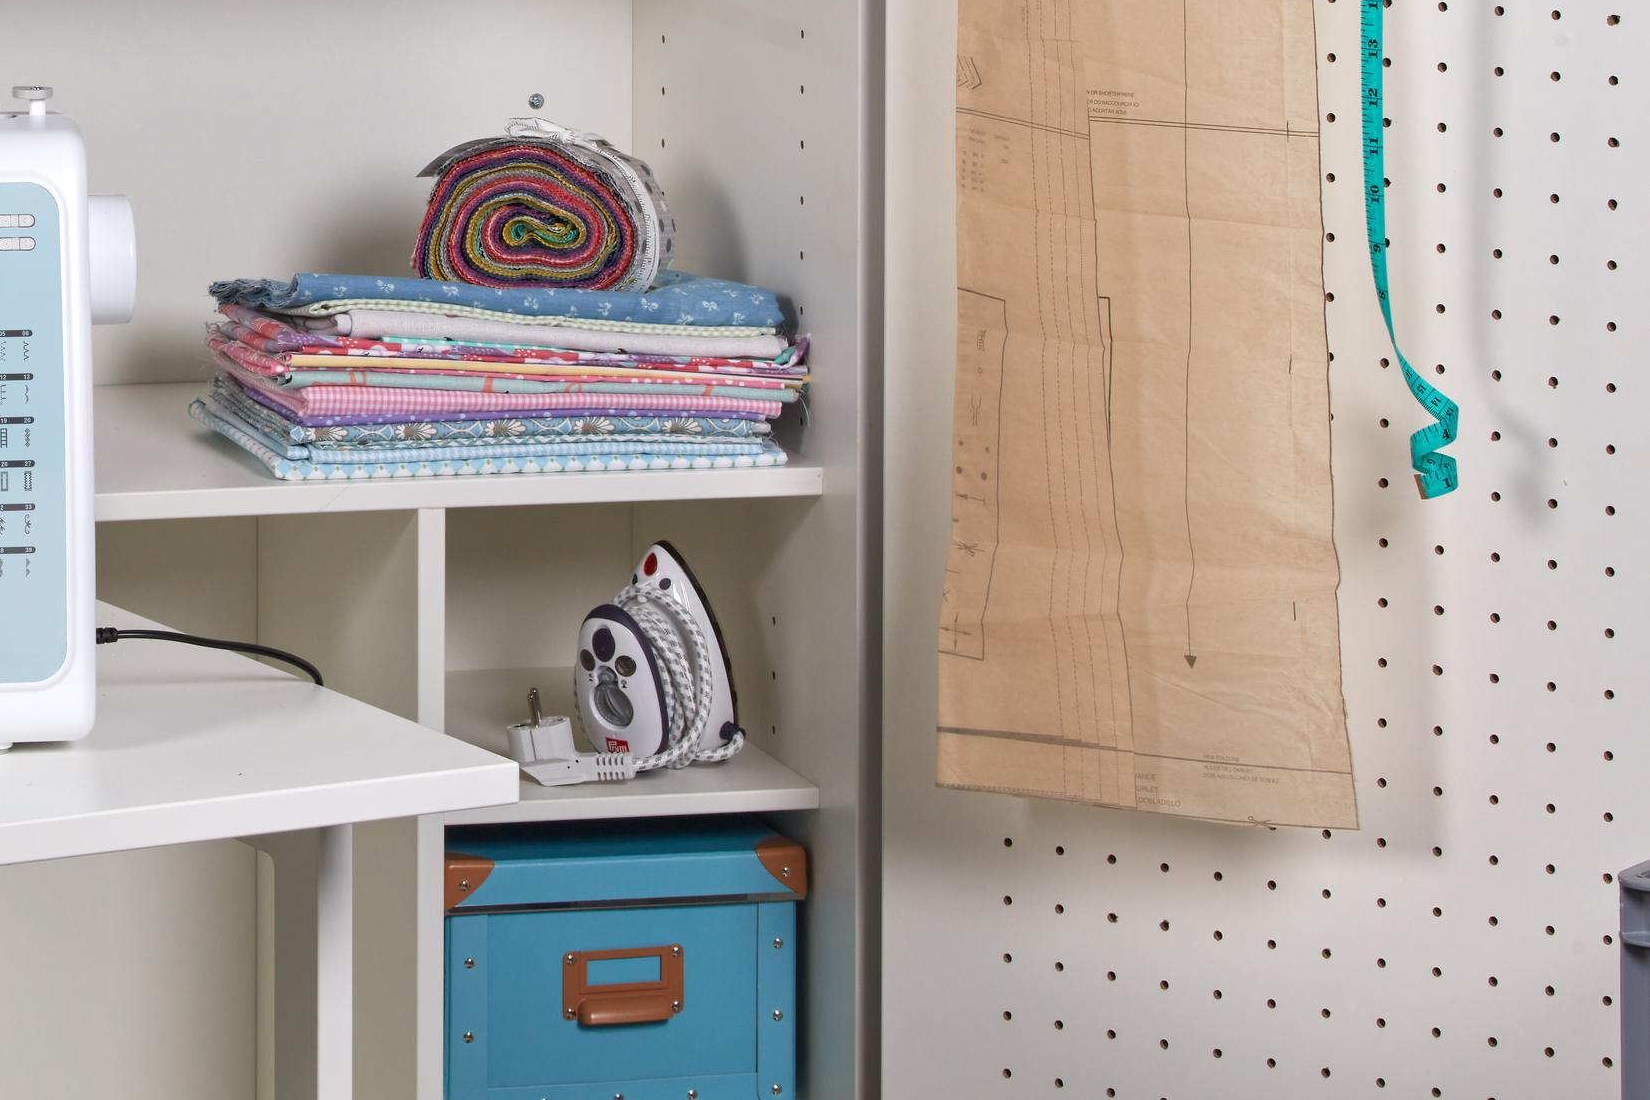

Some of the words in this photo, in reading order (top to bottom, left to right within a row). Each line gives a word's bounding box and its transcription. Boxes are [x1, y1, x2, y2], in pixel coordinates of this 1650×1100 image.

[1368, 39, 1378, 59] 13
[1368, 88, 1378, 108] 12
[1369, 137, 1378, 156] 11
[1370, 184, 1380, 204] 10
[1442, 429, 1450, 440] 4
[1444, 478, 1452, 489] 1
[608, 741, 628, 753] Prym
